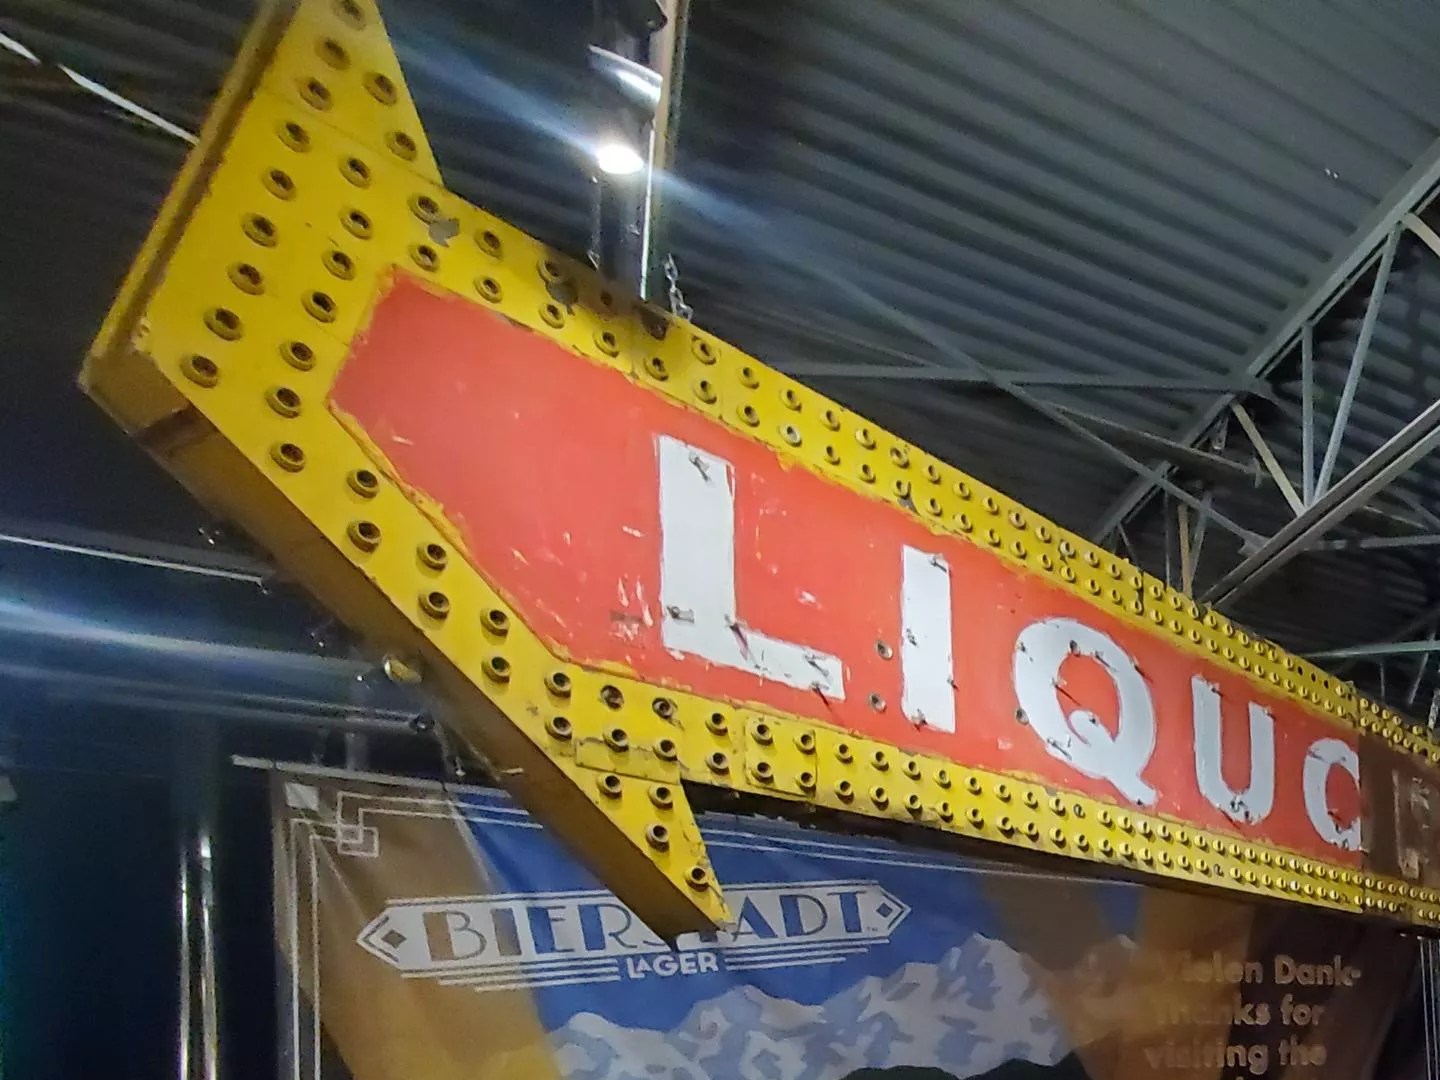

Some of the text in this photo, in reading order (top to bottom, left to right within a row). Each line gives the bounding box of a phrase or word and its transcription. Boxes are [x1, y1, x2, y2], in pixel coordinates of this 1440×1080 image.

[424, 890, 867, 963] BIERADT
[626, 952, 720, 980] LAGER
[1280, 993, 1326, 1026] for
[1279, 1034, 1328, 1067] the
